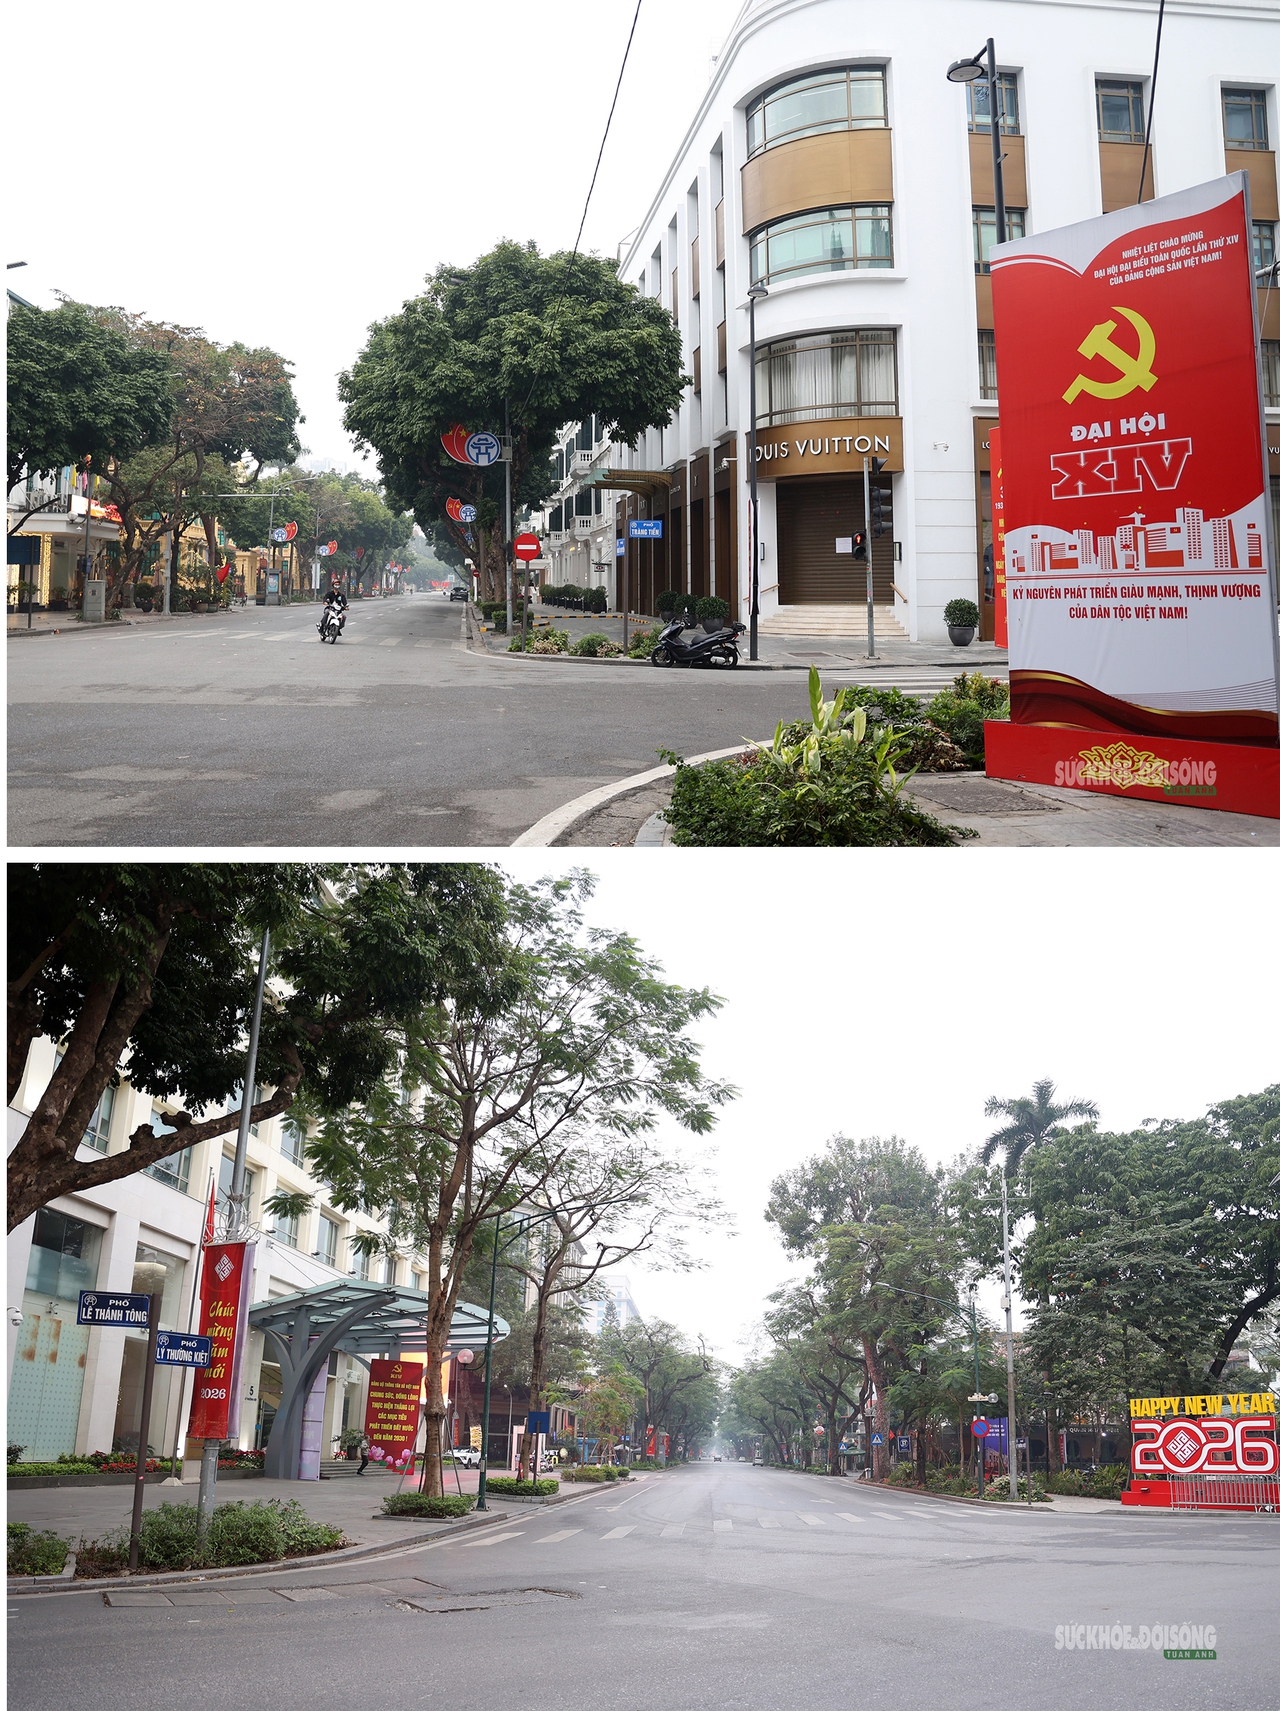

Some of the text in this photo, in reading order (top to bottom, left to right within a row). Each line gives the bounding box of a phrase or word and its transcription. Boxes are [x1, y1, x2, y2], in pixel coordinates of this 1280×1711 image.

[1122, 230, 1204, 260] NHIỆT LIỆT CHÀO MỪNG
[1094, 234, 1239, 279] ĐẠI HỘI ĐẠI BIỂU TOÀN QUỐC LẦN THỨ XIV
[1109, 251, 1223, 286] CỦA ĐẢNG CỘNG SẢN VIỆT NAM!
[1070, 411, 1166, 443] ĐẠI HỘI
[795, 435, 890, 457] VUITTON
[1050, 437, 1193, 500] XIV
[1012, 585, 1024, 600] KỶ
[1026, 585, 1061, 600] NGUYÊN
[1063, 585, 1088, 600] PHÁT
[1089, 581, 1118, 599] TRIỂN
[1120, 583, 1144, 599] GIÀU
[1147, 585, 1182, 601] MẠNH,
[1185, 584, 1218, 601] THỊNH
[1221, 583, 1261, 601] VƯỢNG
[1069, 602, 1188, 622] CỦA DÂN TỘC VIỆT NAM!
[109, 1298, 131, 1307] PHỐ
[209, 1301, 235, 1317] Chúc
[82, 1306, 147, 1322] LÊ THÁNH TÔNG
[206, 1322, 234, 1341] mừng
[180, 1339, 198, 1348] PHỐ
[210, 1343, 229, 1358] ăm
[156, 1346, 209, 1365] LÝ THƯỜNG KIỆT
[203, 1362, 225, 1379] mới
[200, 1387, 227, 1400] 2026
[249, 1385, 254, 1396] 5
[1130, 1392, 1276, 1417] HAPPY NEW YEAR
[369, 1422, 380, 1430] PHÁT
[378, 1412, 387, 1420] CÁC
[387, 1413, 397, 1421] MỤC
[1132, 1418, 1277, 1474] 2026
